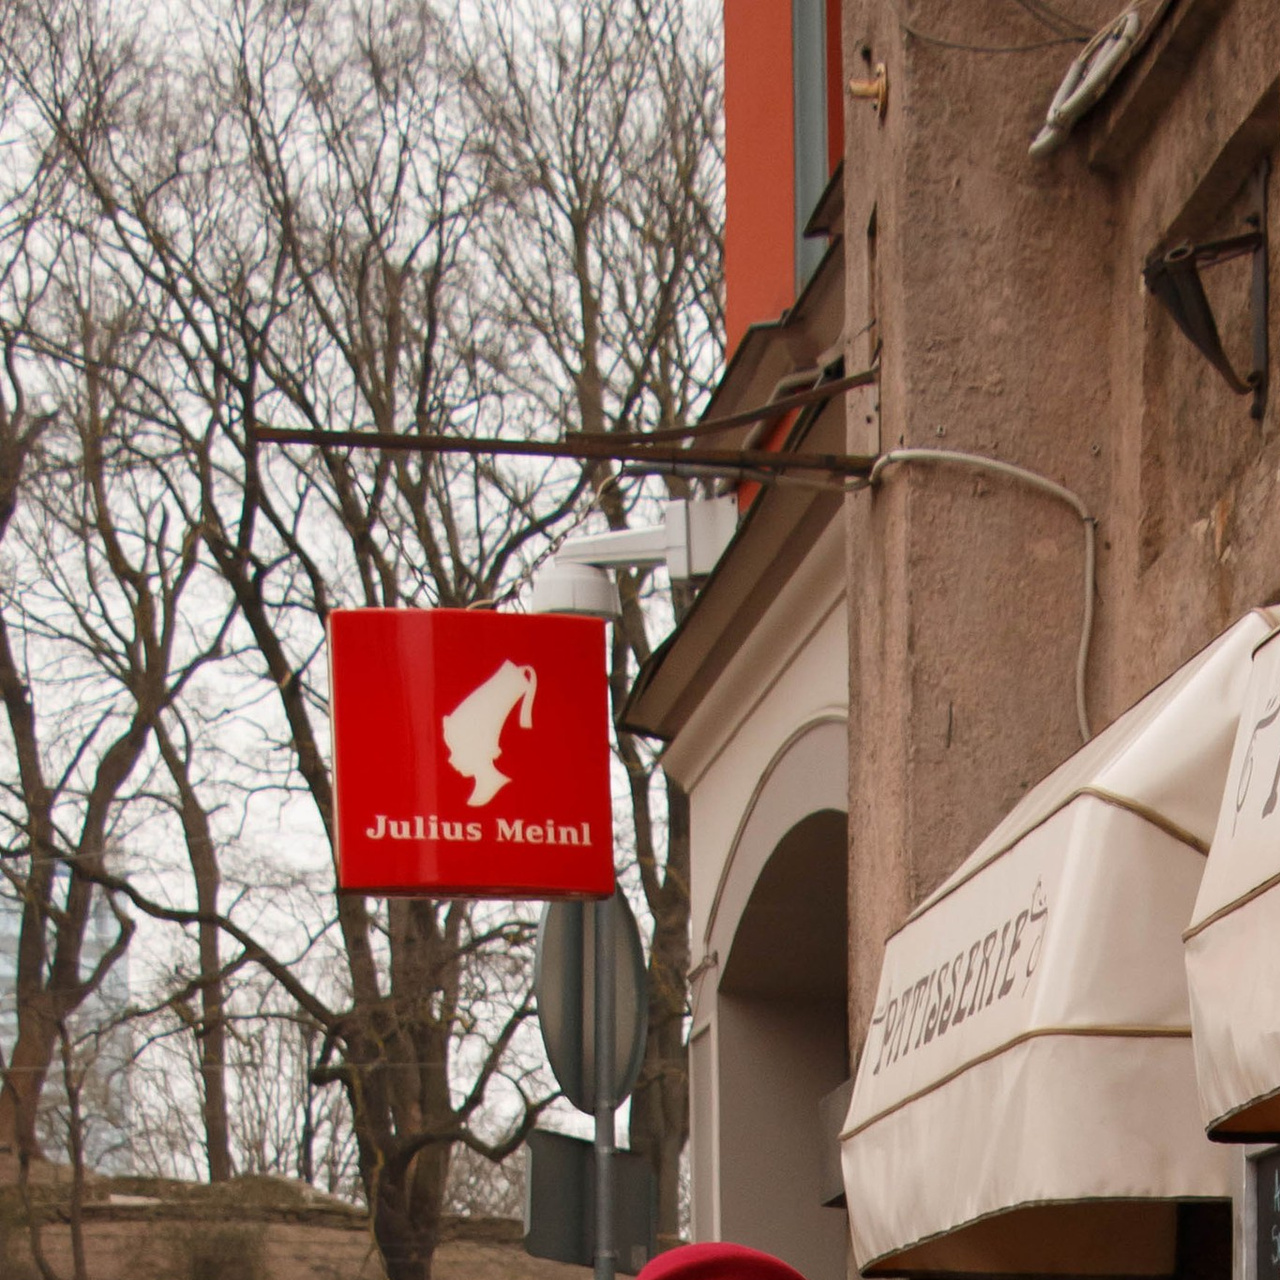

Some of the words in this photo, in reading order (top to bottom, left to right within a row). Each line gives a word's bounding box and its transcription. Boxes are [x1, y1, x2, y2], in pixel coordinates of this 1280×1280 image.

[366, 814, 483, 842] Julius
[496, 818, 593, 846] Meinl
[872, 908, 1029, 1076] PATISSERIE
